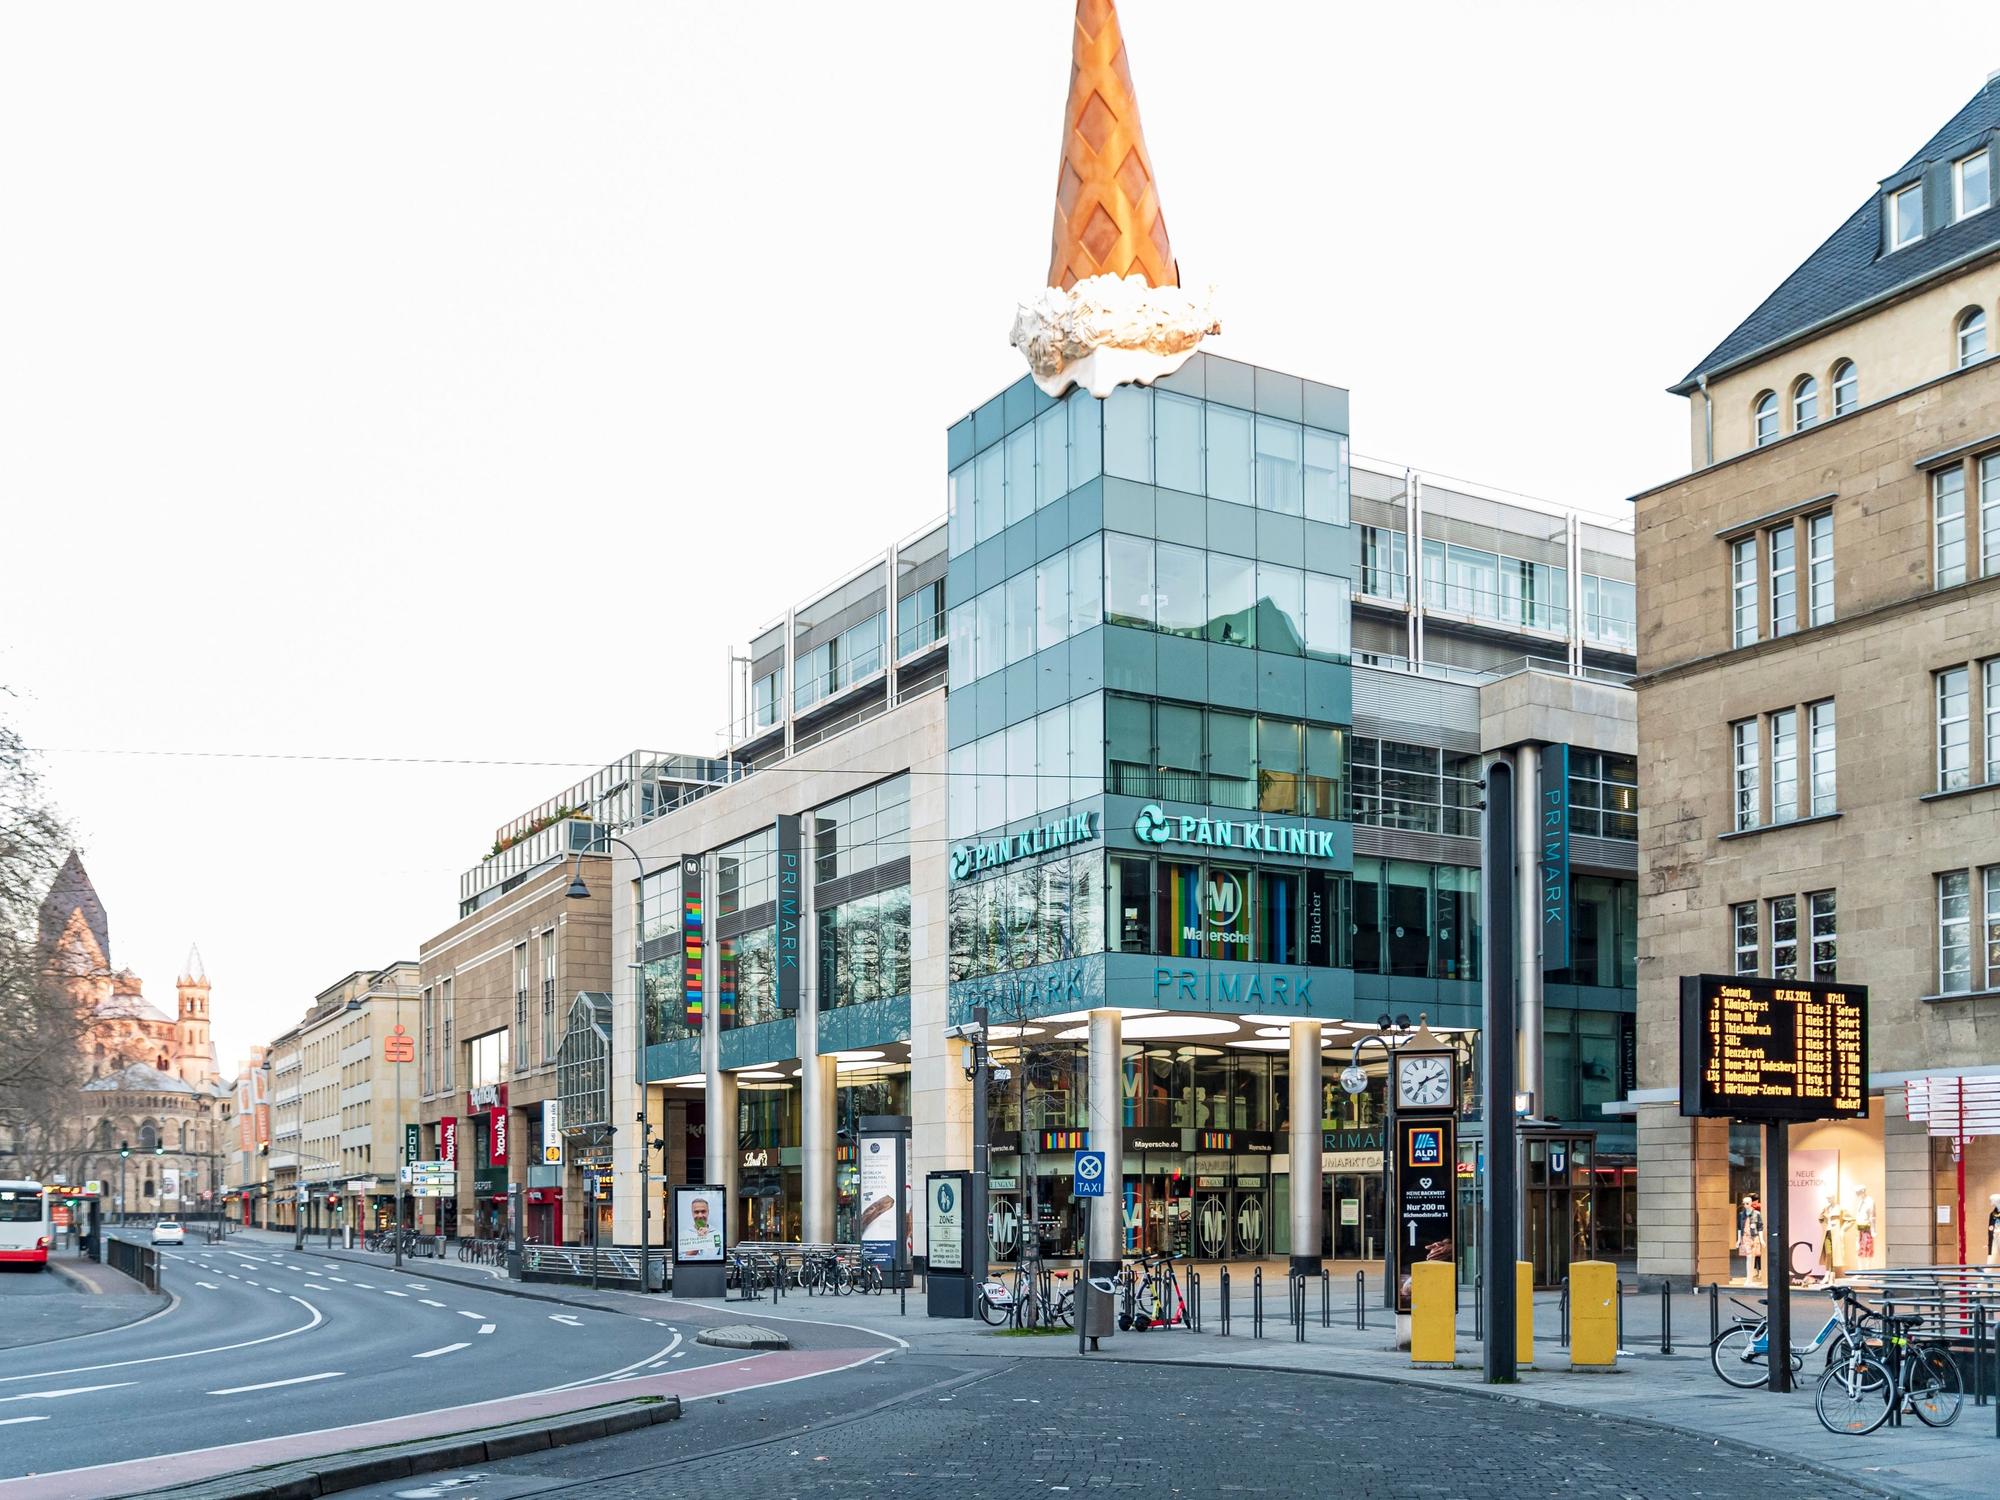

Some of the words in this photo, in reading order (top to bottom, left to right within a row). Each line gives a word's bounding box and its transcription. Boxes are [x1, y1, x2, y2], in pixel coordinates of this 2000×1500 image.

[975, 837, 1010, 871] PAN
[1019, 811, 1093, 857] KLINIK
[1180, 815, 1232, 847] PAN
[1244, 822, 1334, 858] KLINIK
[1545, 790, 1561, 924] PRIMARK
[782, 854, 797, 968] PRIMARK
[1310, 892, 1322, 945] Bücher
[1183, 926, 1249, 944] Maersche
[963, 969, 1082, 1018] PRIMARK
[1153, 967, 1313, 1007] PRIMARK
[1721, 986, 1750, 1000] Sonntag
[1776, 990, 1811, 1002] 07.03.2021
[1828, 993, 1845, 1004] 07:11
[1714, 998, 1719, 1008] 9
[1724, 999, 1768, 1012] Königsforst
[1806, 1004, 1824, 1015] Gleis
[1826, 1006, 1831, 1015] 3
[1837, 1006, 1860, 1017] Sofort
[1711, 1010, 1719, 1020] 18
[1724, 1012, 1741, 1022] Bonn
[1745, 1013, 1757, 1022] Hbf
[1806, 1016, 1824, 1026] Gleis
[1826, 1017, 1831, 1026] 2
[1837, 1018, 1860, 1028] Sofort
[1711, 1022, 1719, 1032] 18
[1725, 1024, 1771, 1035] Thielenbruch
[1806, 1028, 1824, 1038] Gleis
[1826, 1029, 1831, 1038] 1
[1837, 1030, 1860, 1040] Sofort
[1714, 1035, 1719, 1044] 9
[1806, 1040, 1824, 1050] Gleis
[1826, 1040, 1831, 1050] 4
[1837, 1041, 1860, 1052] Sofort
[1715, 1047, 1719, 1057] 7
[1806, 1052, 1824, 1061] Gleis
[1826, 1052, 1831, 1061] 5
[1841, 1053, 1845, 1062] 5
[1848, 1053, 1859, 1063] Min
[1711, 1059, 1719, 1068] 16
[1725, 1059, 1757, 1071] Bonn-Bad
[1761, 1061, 1796, 1073] Godesberg
[1806, 1063, 1824, 1073] Gleis
[1826, 1064, 1831, 1073] 2
[1841, 1065, 1845, 1074] 6
[1848, 1065, 1859, 1075] Min
[1707, 1071, 1719, 1081] 136
[1725, 1071, 1760, 1083] Hohenlind
[1841, 1076, 1845, 1085] 7
[1848, 1077, 1859, 1086] Min
[1714, 1083, 1719, 1093] 3
[1725, 1084, 1791, 1097] Görlinger-Zentrum
[1806, 1086, 1824, 1096] Gleis
[1827, 1087, 1831, 1096] 1
[1848, 1088, 1859, 1098] Min
[1837, 1099, 1860, 1109] Maske?
[408, 1128, 417, 1160] EPOT
[1134, 1140, 1179, 1150] Mayersche.de
[1324, 1133, 1384, 1149] RIMA
[1415, 1149, 1437, 1157] ALDI
[1552, 1154, 1565, 1172] U
[1796, 1170, 1815, 1178] NEUE
[1077, 1182, 1101, 1193] TAXI
[1406, 1203, 1420, 1211] Nur
[939, 1215, 954, 1224] ZONE
